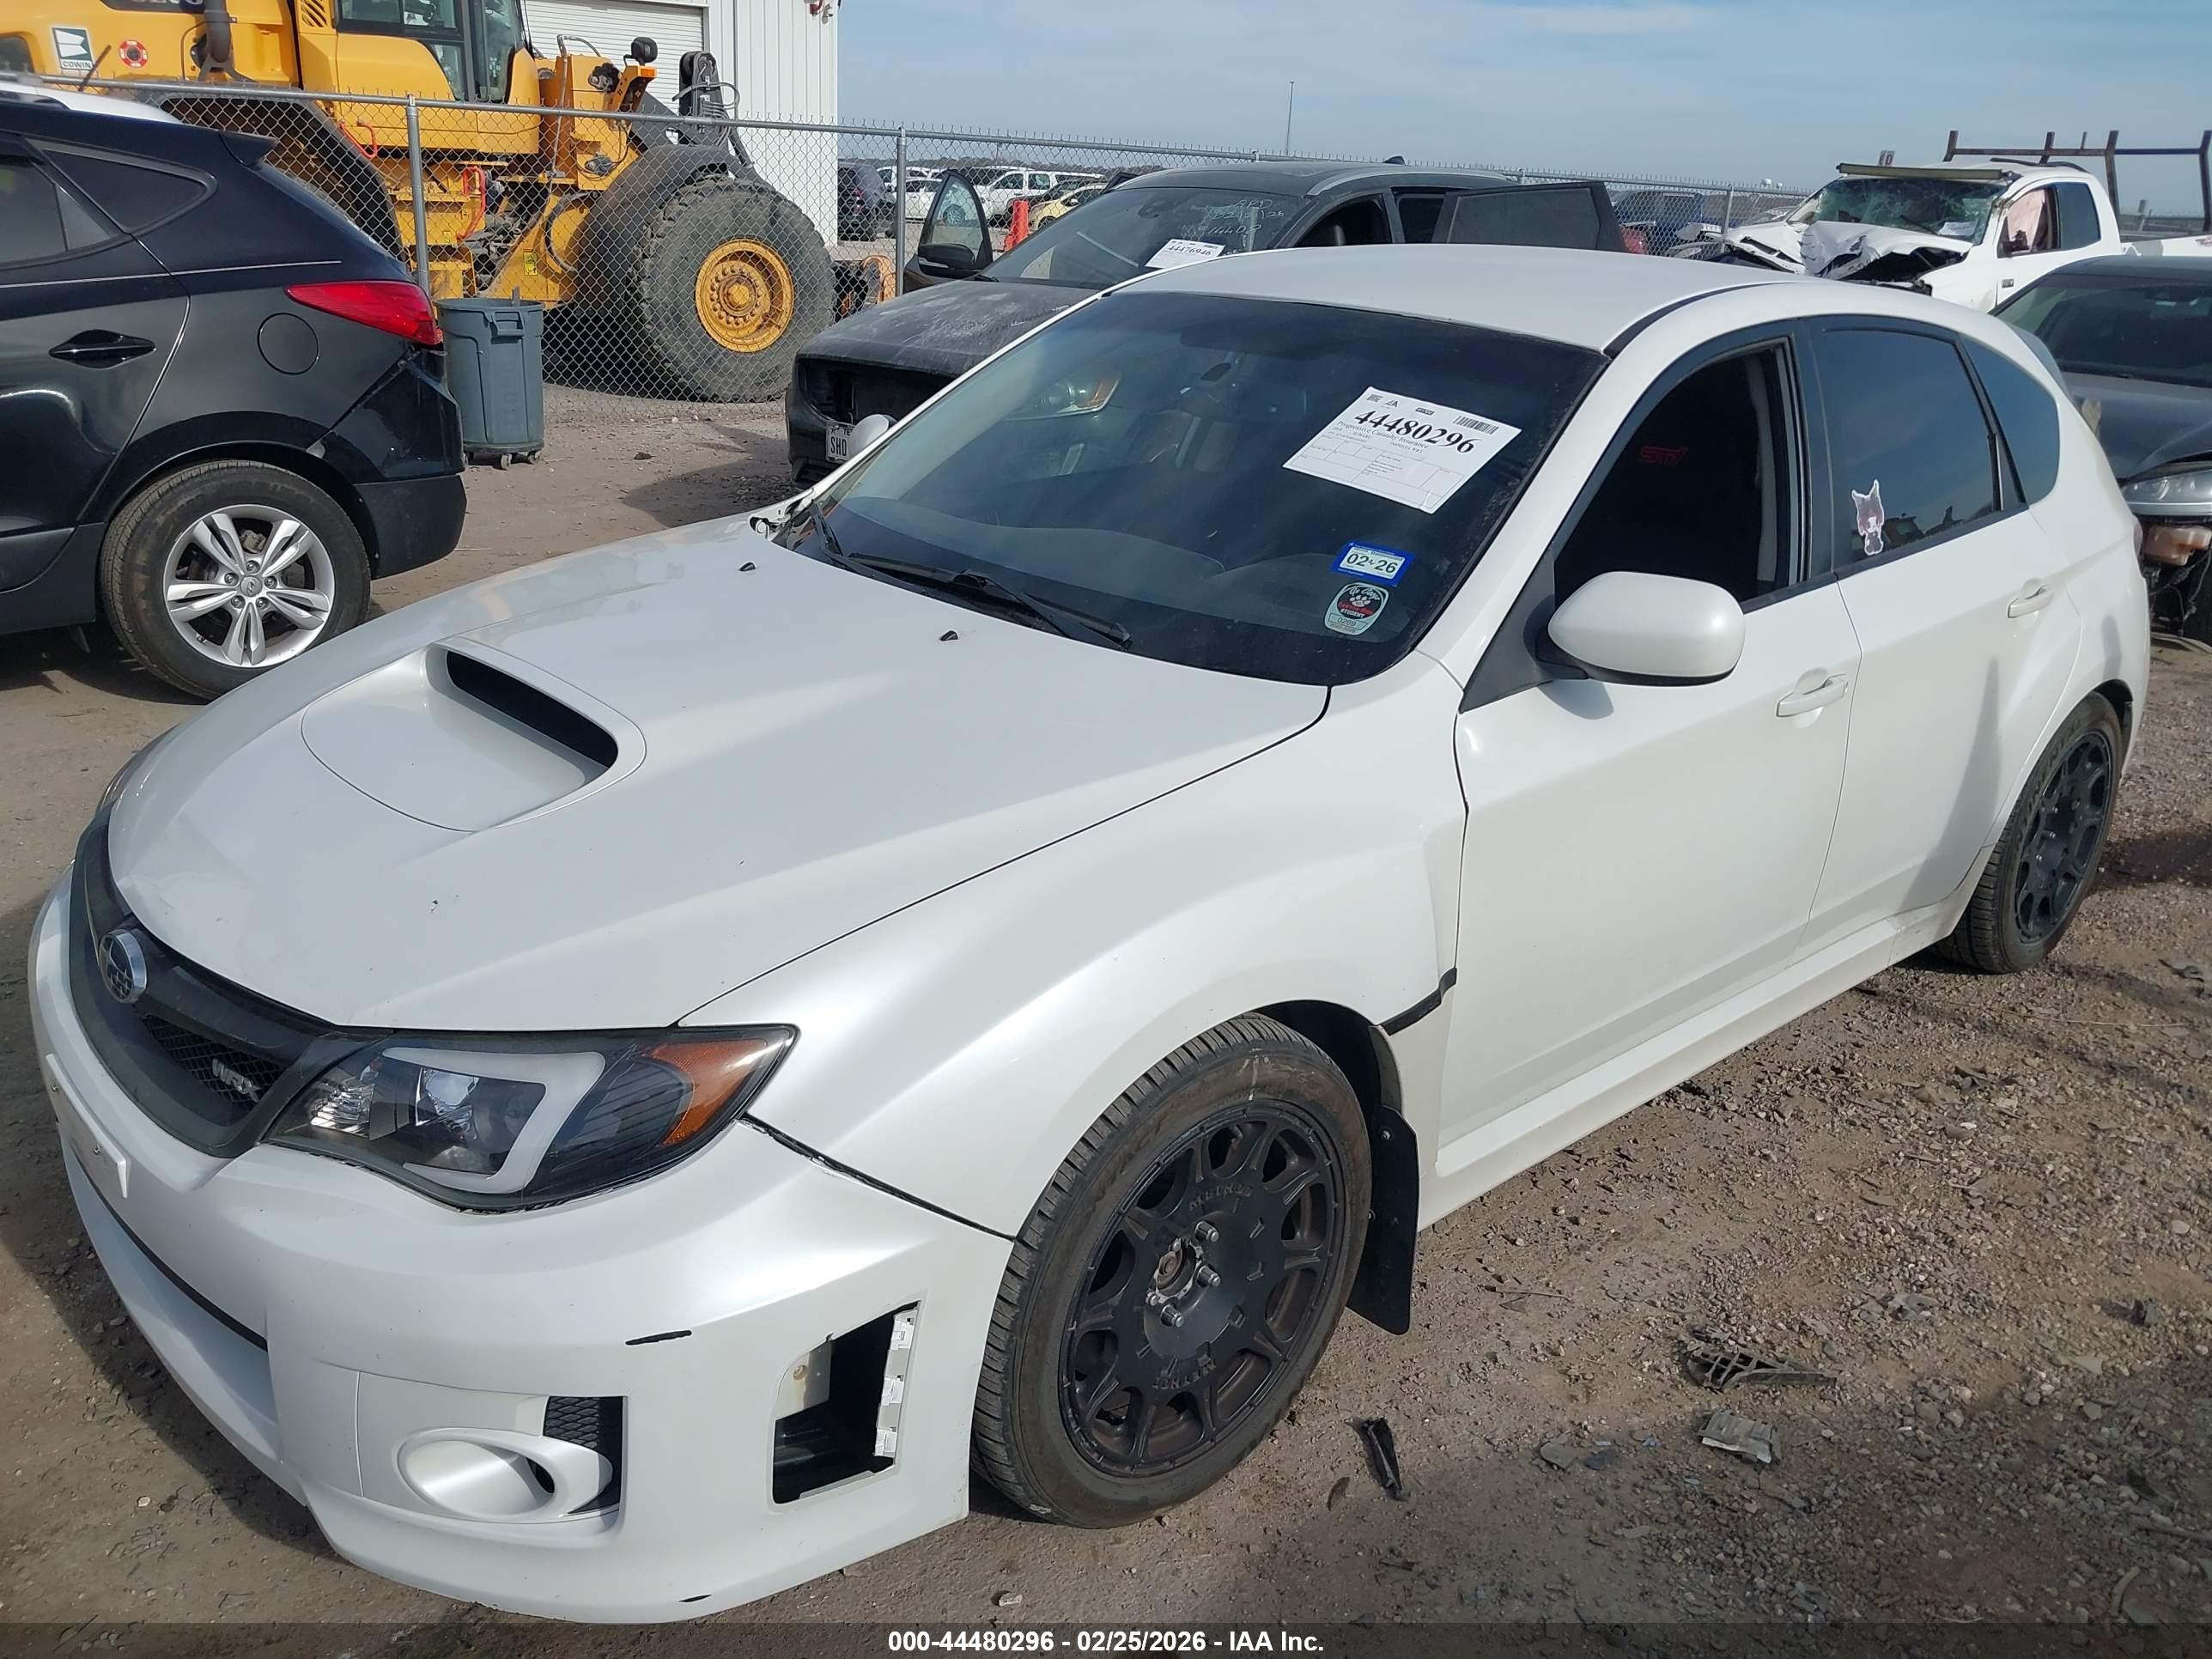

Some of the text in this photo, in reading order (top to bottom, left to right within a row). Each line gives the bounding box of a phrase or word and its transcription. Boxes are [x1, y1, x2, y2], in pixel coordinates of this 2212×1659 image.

[63, 60, 92, 70] COWIN
[1168, 246, 1212, 256] 44476946
[1354, 410, 1483, 453] 44480296
[1399, 437, 1430, 449] Insurance
[212, 1058, 261, 1103] WRX
